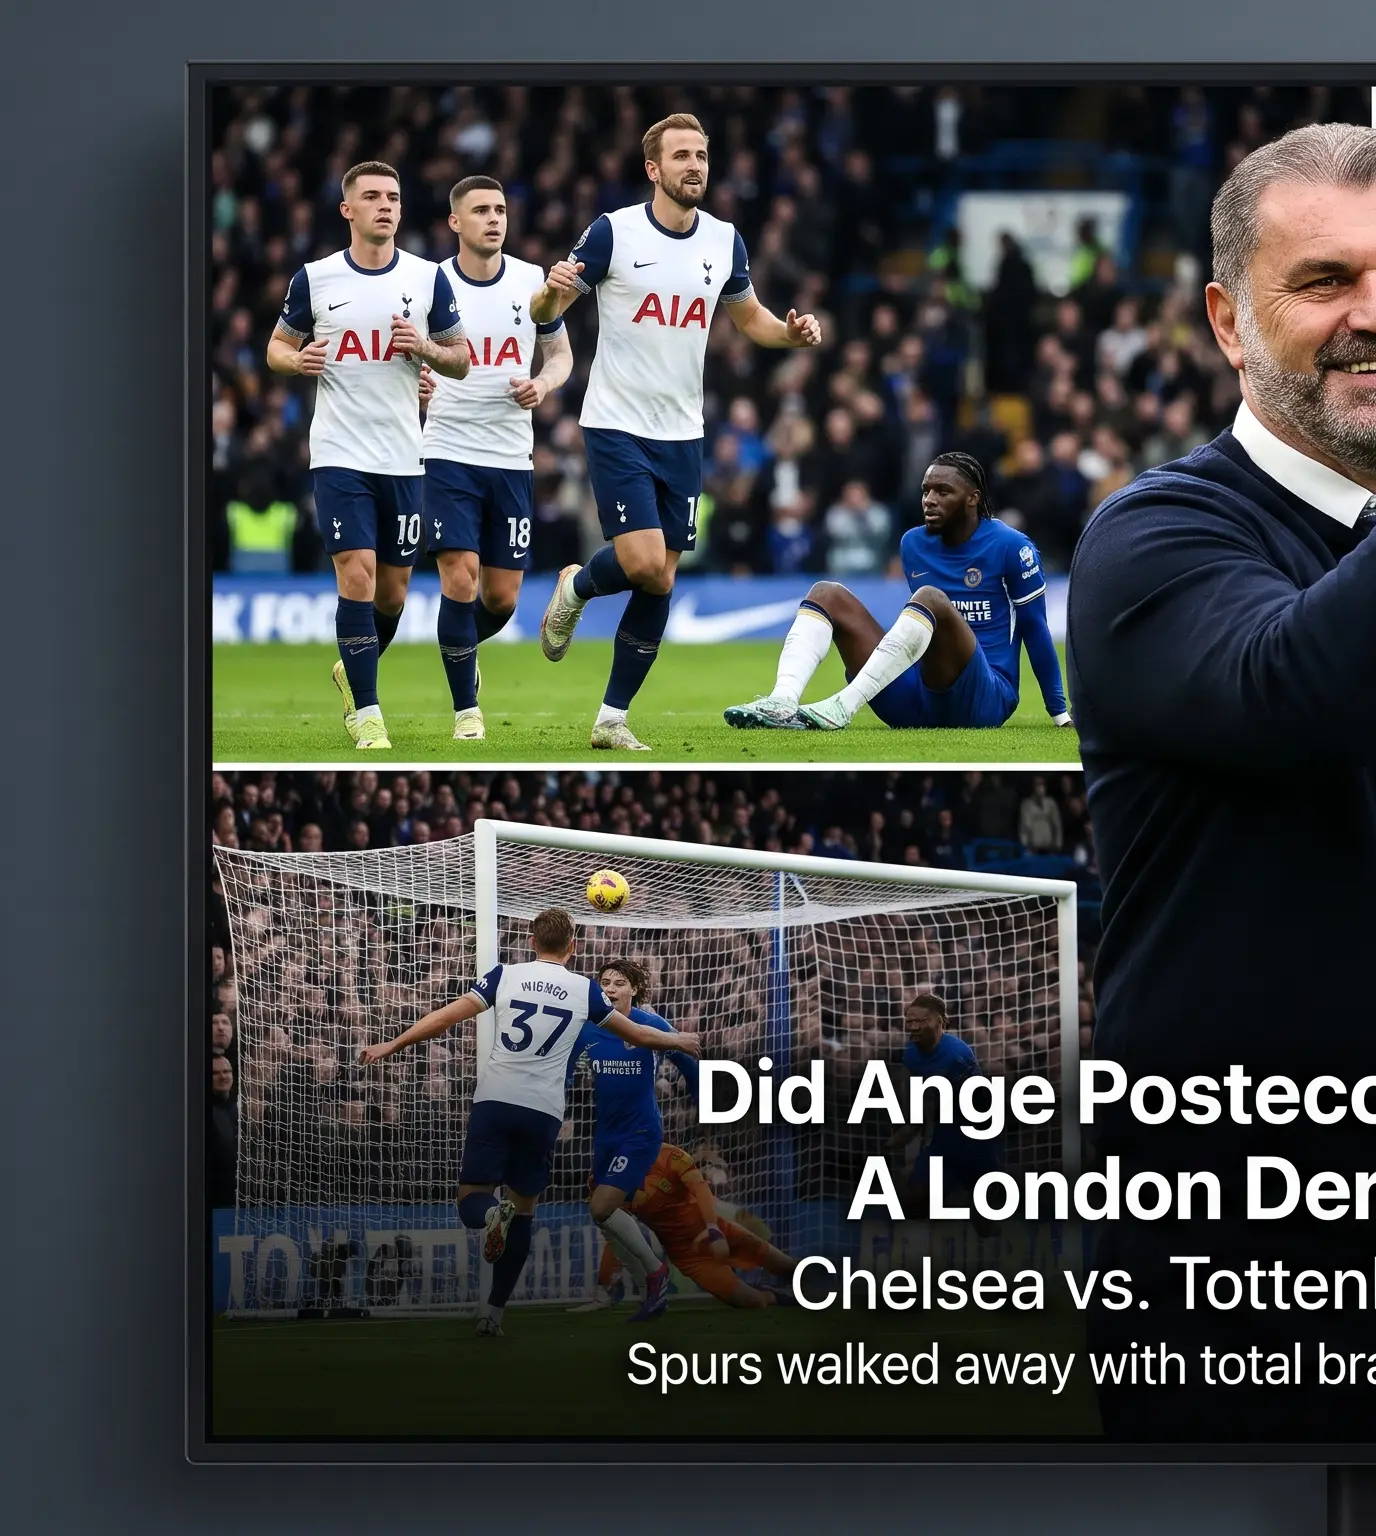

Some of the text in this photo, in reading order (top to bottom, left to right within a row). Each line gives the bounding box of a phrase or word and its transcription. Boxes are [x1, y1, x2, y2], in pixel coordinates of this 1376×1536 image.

[632, 293, 706, 329] AIA
[397, 513, 420, 545] 10
[508, 517, 531, 548] 18
[501, 999, 573, 1057] 37
[699, 1056, 825, 1125] Did
[847, 1059, 1056, 1140] Ange
[847, 1156, 906, 1220] A
[929, 1155, 1221, 1221] London
[792, 1255, 1044, 1310] Chelsea
[1063, 1269, 1149, 1310] vs.
[627, 1342, 762, 1394] Spurs
[777, 1342, 938, 1385] walked
[955, 1353, 1076, 1395] away
[1089, 1341, 1185, 1385] with
[1200, 1342, 1301, 1385] total
